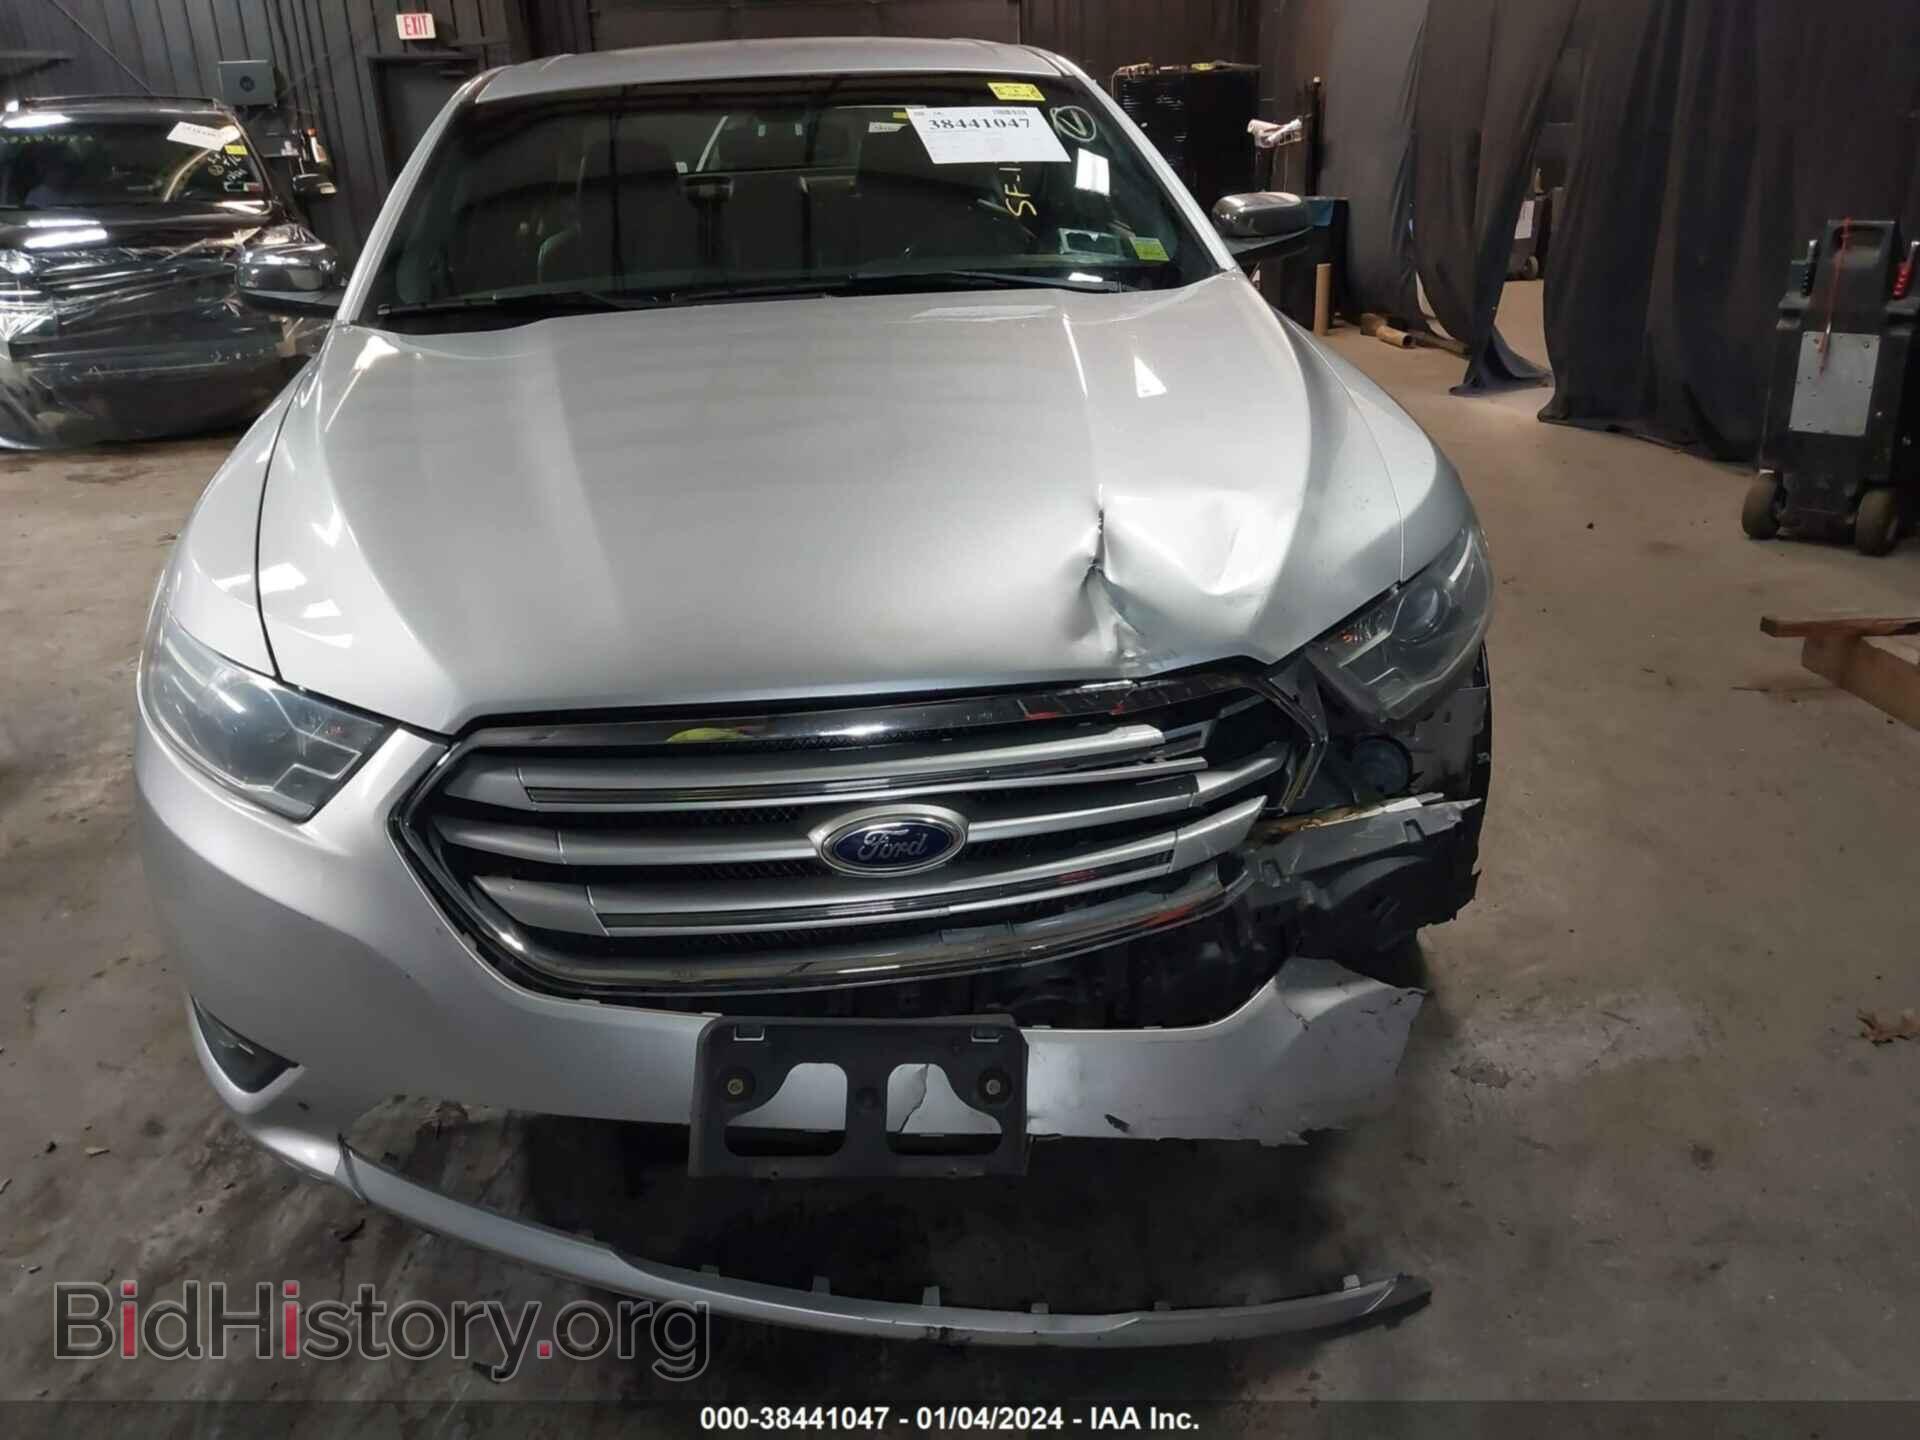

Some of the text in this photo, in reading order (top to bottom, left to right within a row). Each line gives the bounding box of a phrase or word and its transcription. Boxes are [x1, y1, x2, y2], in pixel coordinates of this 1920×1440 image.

[403, 15, 428, 36] EXIT
[928, 118, 1031, 130] 38441047
[857, 827, 929, 861] Ford
